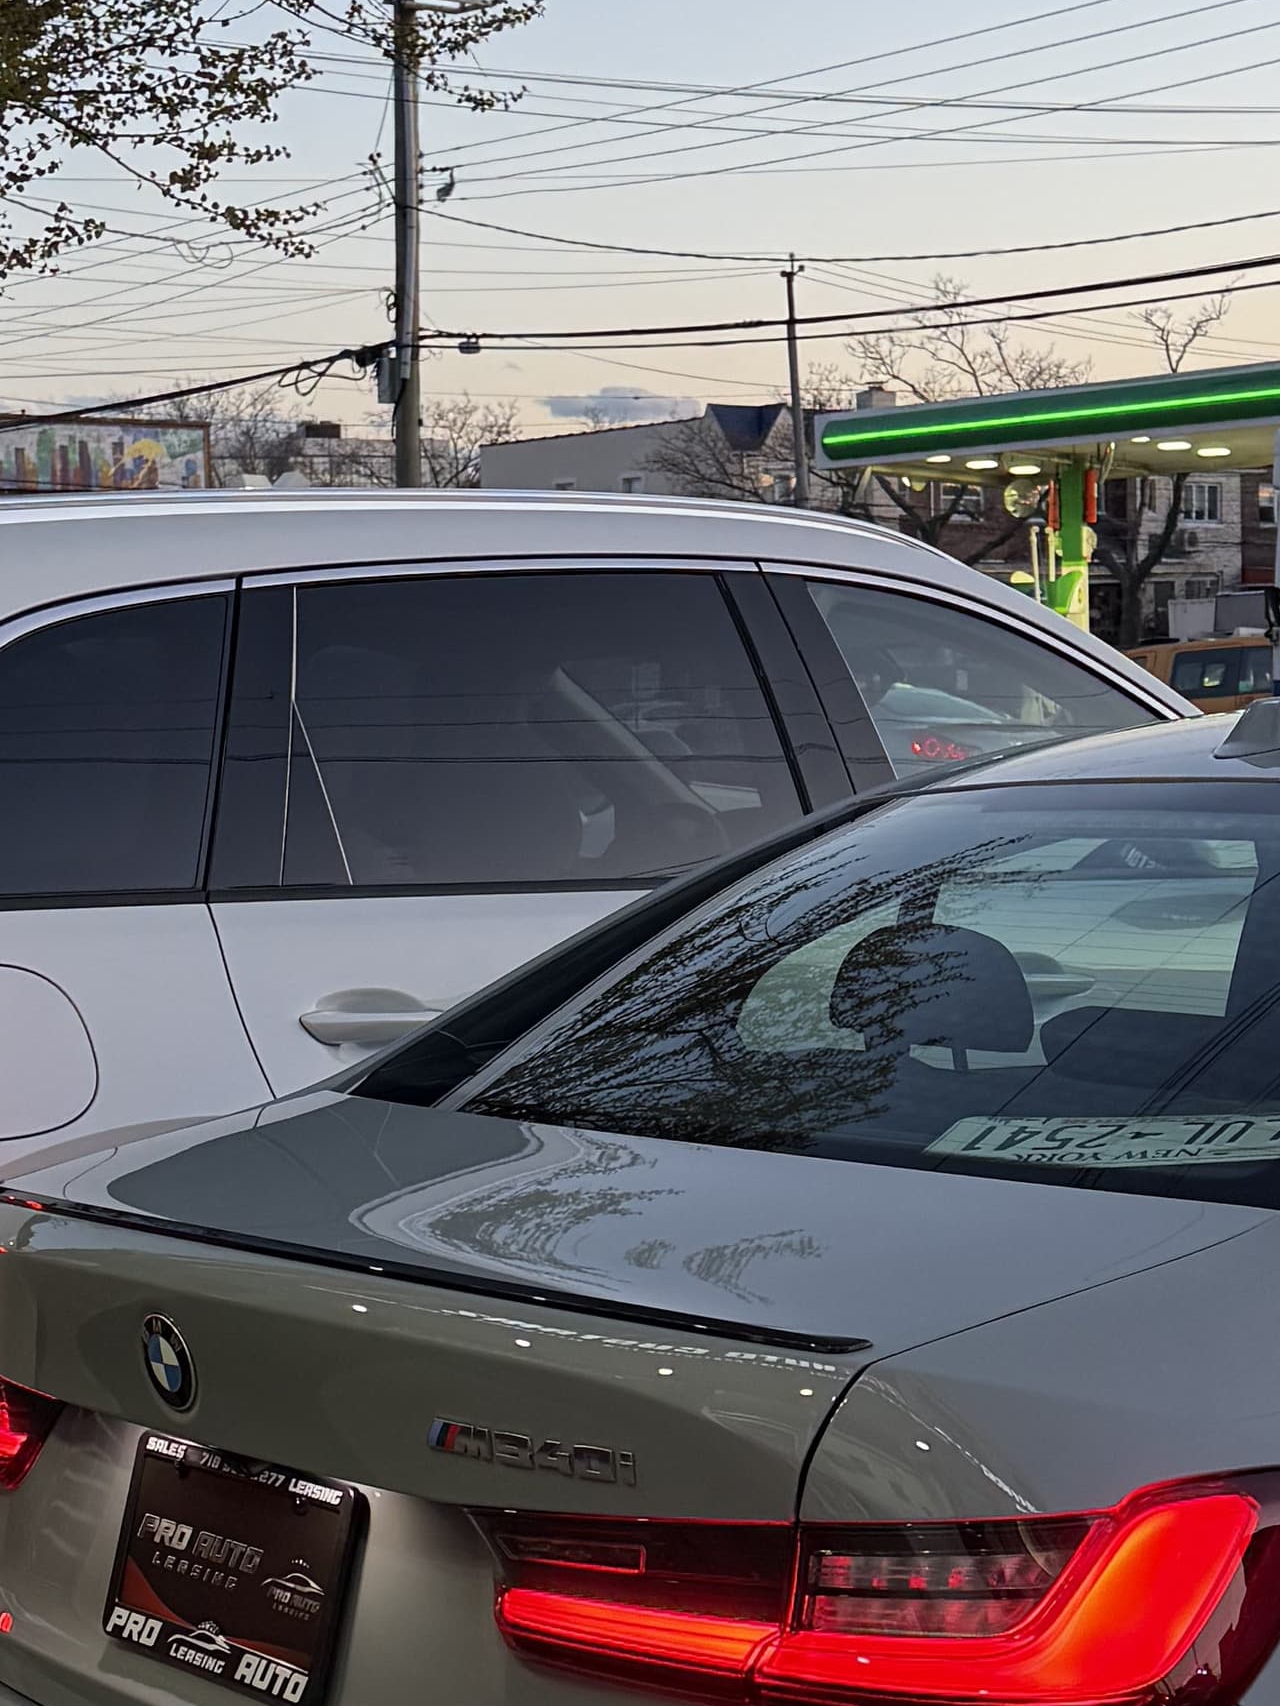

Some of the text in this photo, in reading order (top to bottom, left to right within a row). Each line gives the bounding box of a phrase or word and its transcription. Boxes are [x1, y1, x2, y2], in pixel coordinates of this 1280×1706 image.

[961, 1124, 1124, 1151] 2541
[1117, 1147, 1203, 1162] NEW
[146, 1436, 187, 1459] SALES
[288, 1477, 344, 1505] LEASING
[437, 1417, 637, 1487] M340i
[137, 1513, 265, 1575] PRO AUTO
[151, 1551, 239, 1591] LEASING
[106, 1605, 309, 1703] PRO LEASING AUTO
